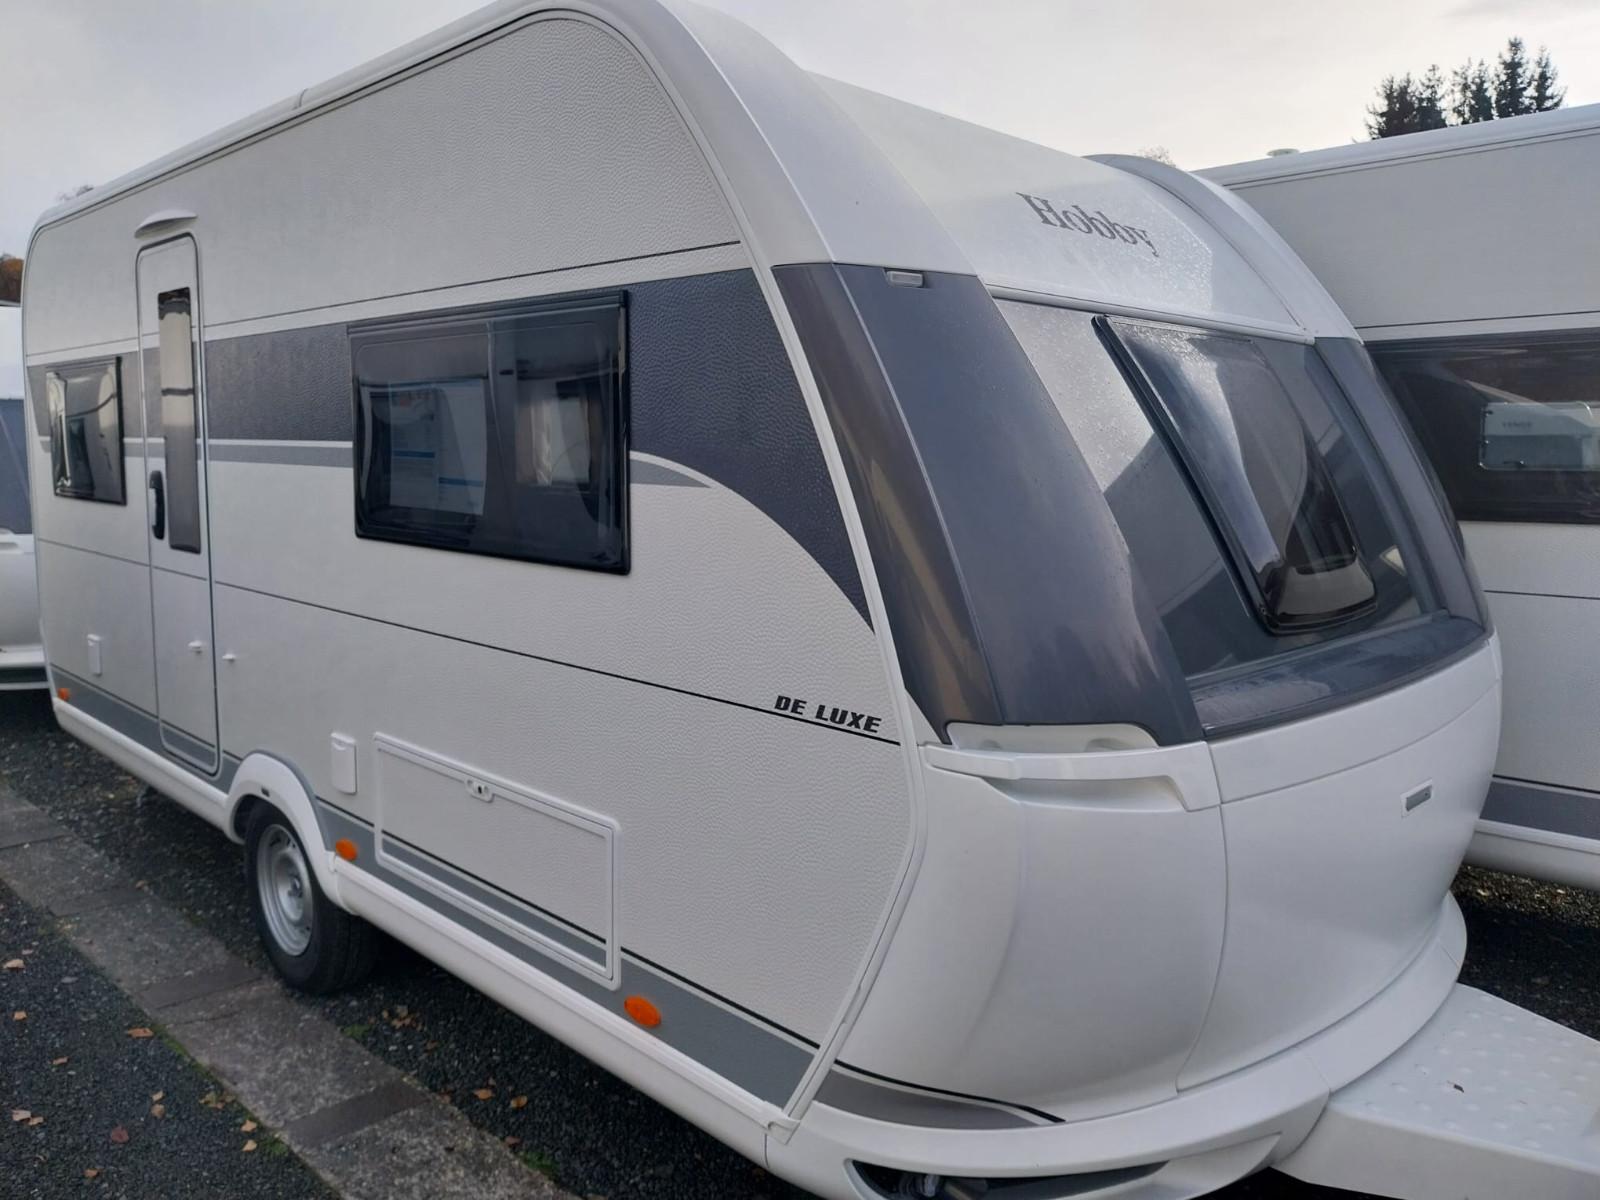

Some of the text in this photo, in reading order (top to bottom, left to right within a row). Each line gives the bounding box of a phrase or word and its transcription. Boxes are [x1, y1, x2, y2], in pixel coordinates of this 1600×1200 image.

[1015, 191, 1160, 258] Hobby
[774, 695, 882, 734] DE LUXE
